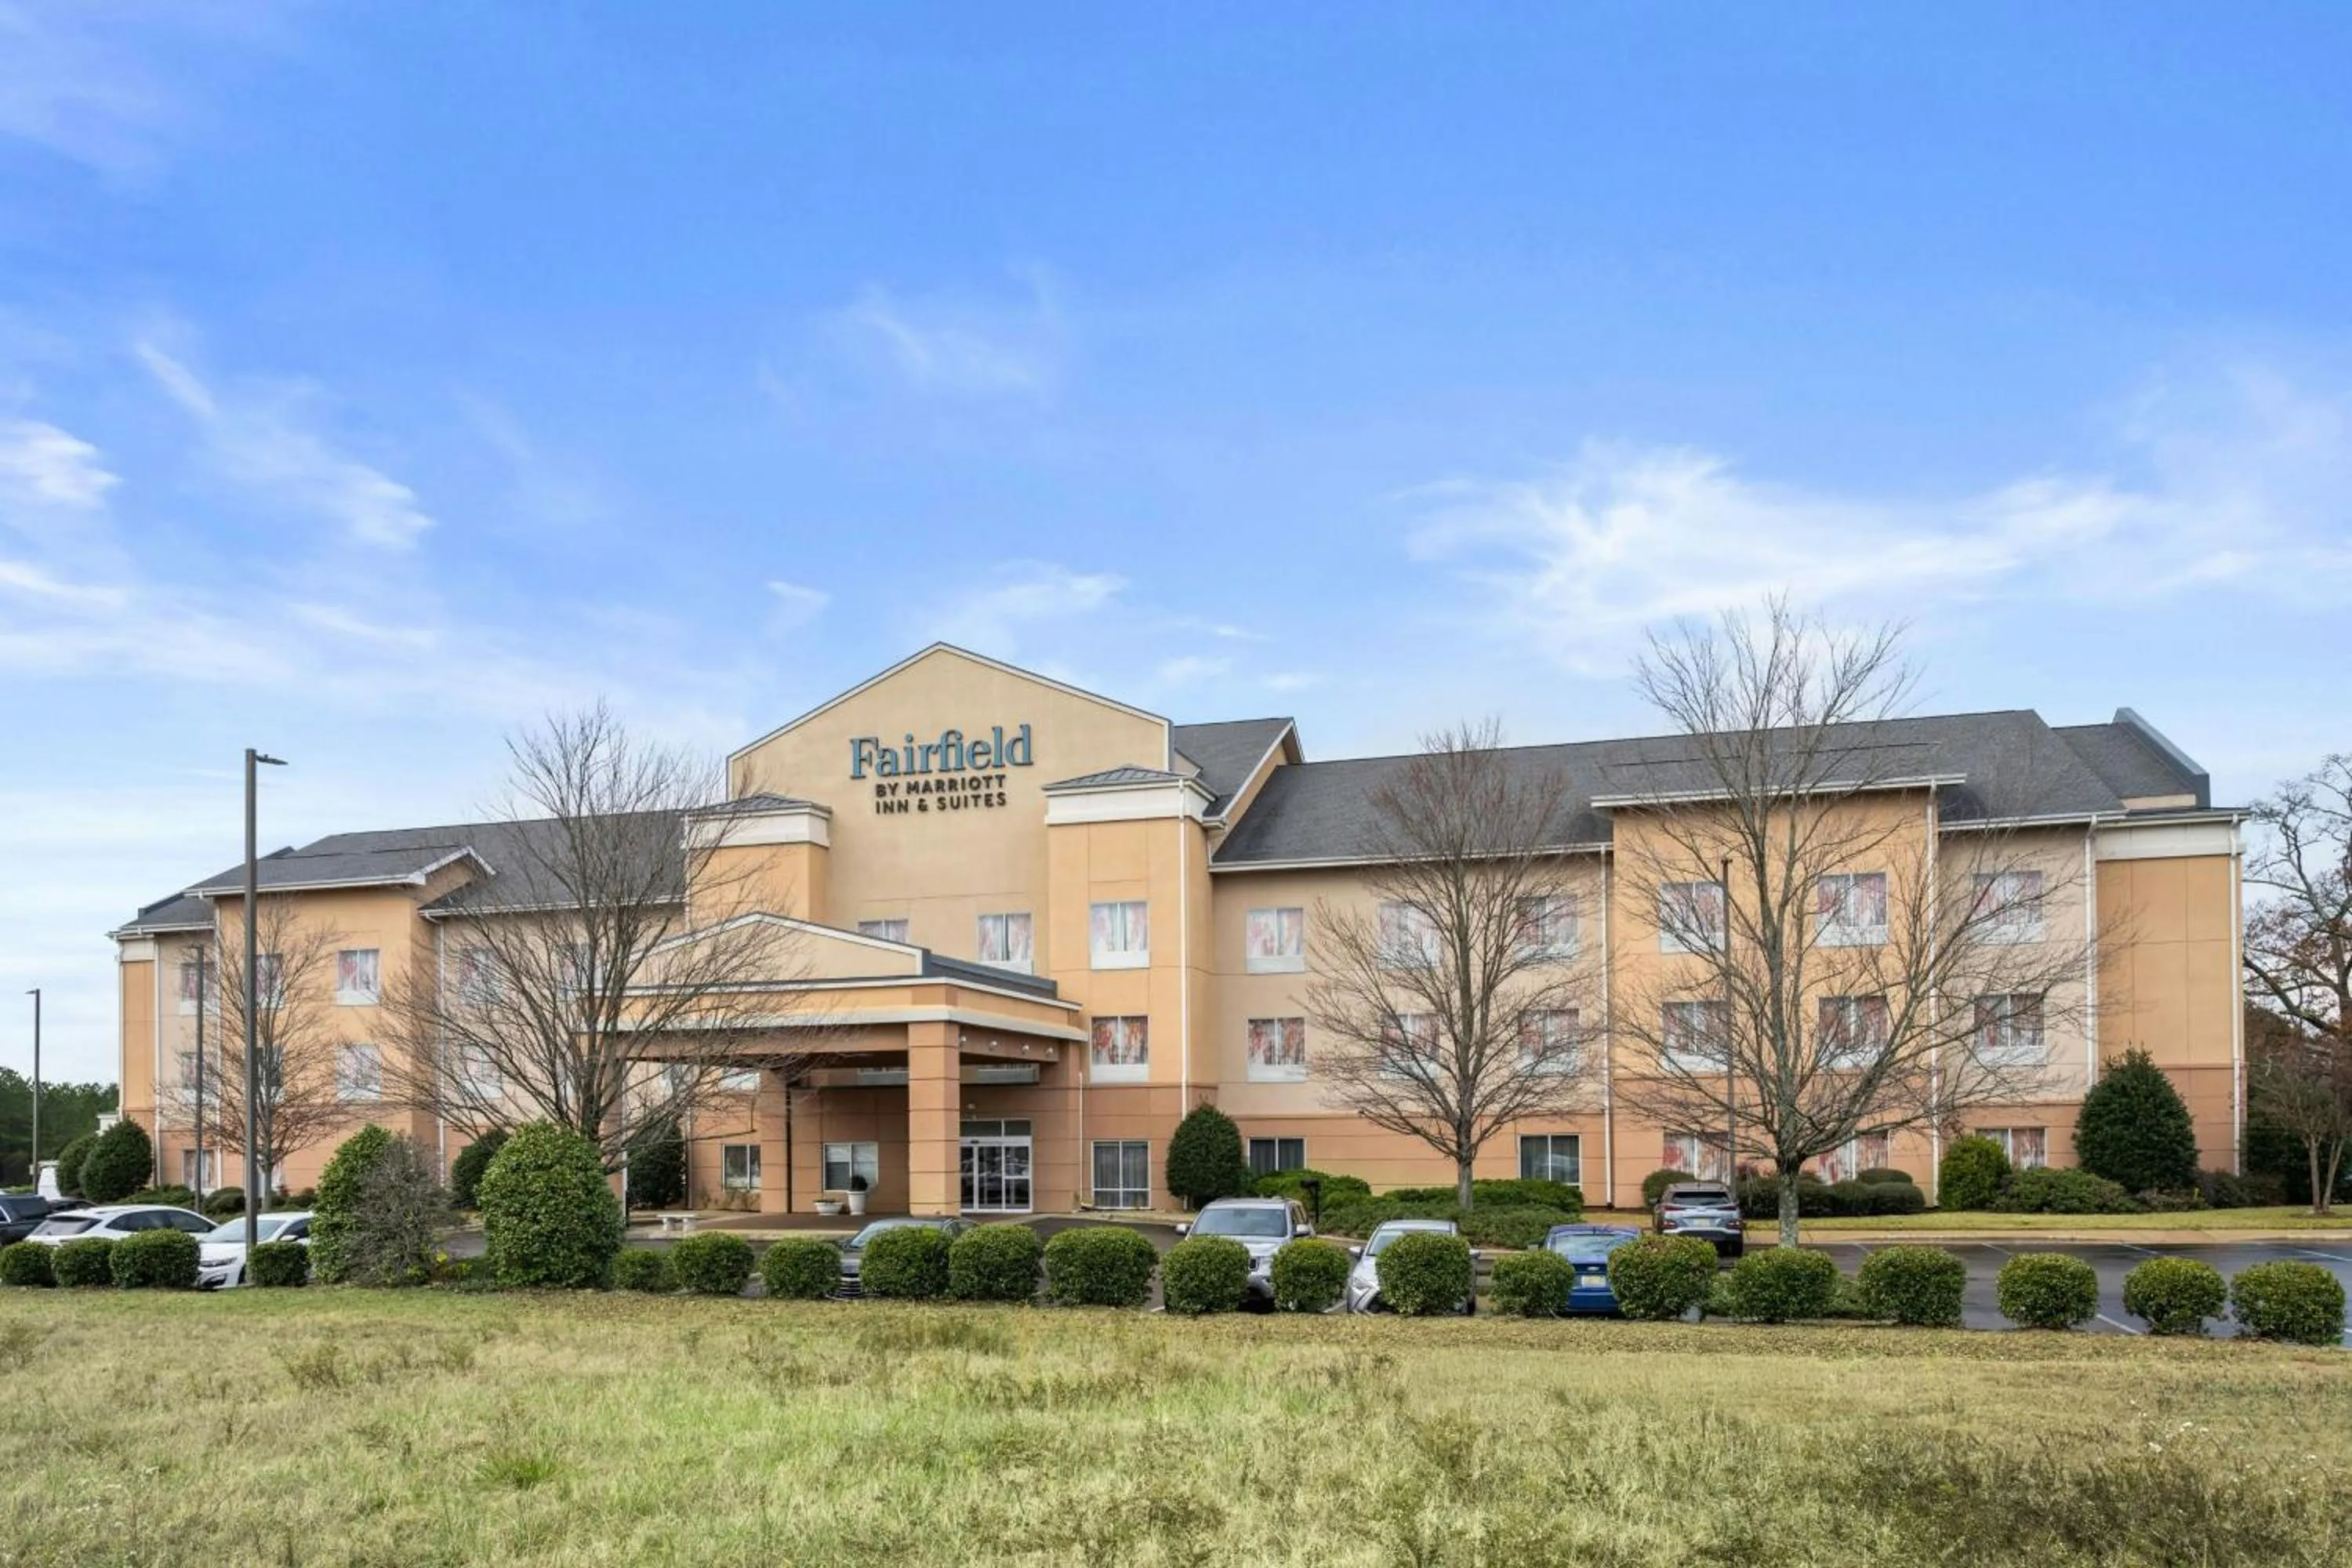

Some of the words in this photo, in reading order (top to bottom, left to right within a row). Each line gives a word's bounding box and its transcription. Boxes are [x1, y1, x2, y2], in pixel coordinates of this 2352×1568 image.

[850, 724, 1033, 779] Fairfield
[875, 782, 898, 798] BY
[906, 774, 1007, 794] MARRIOTT
[875, 799, 909, 815] INN
[917, 797, 929, 812] &
[937, 791, 1007, 811] SUITES
